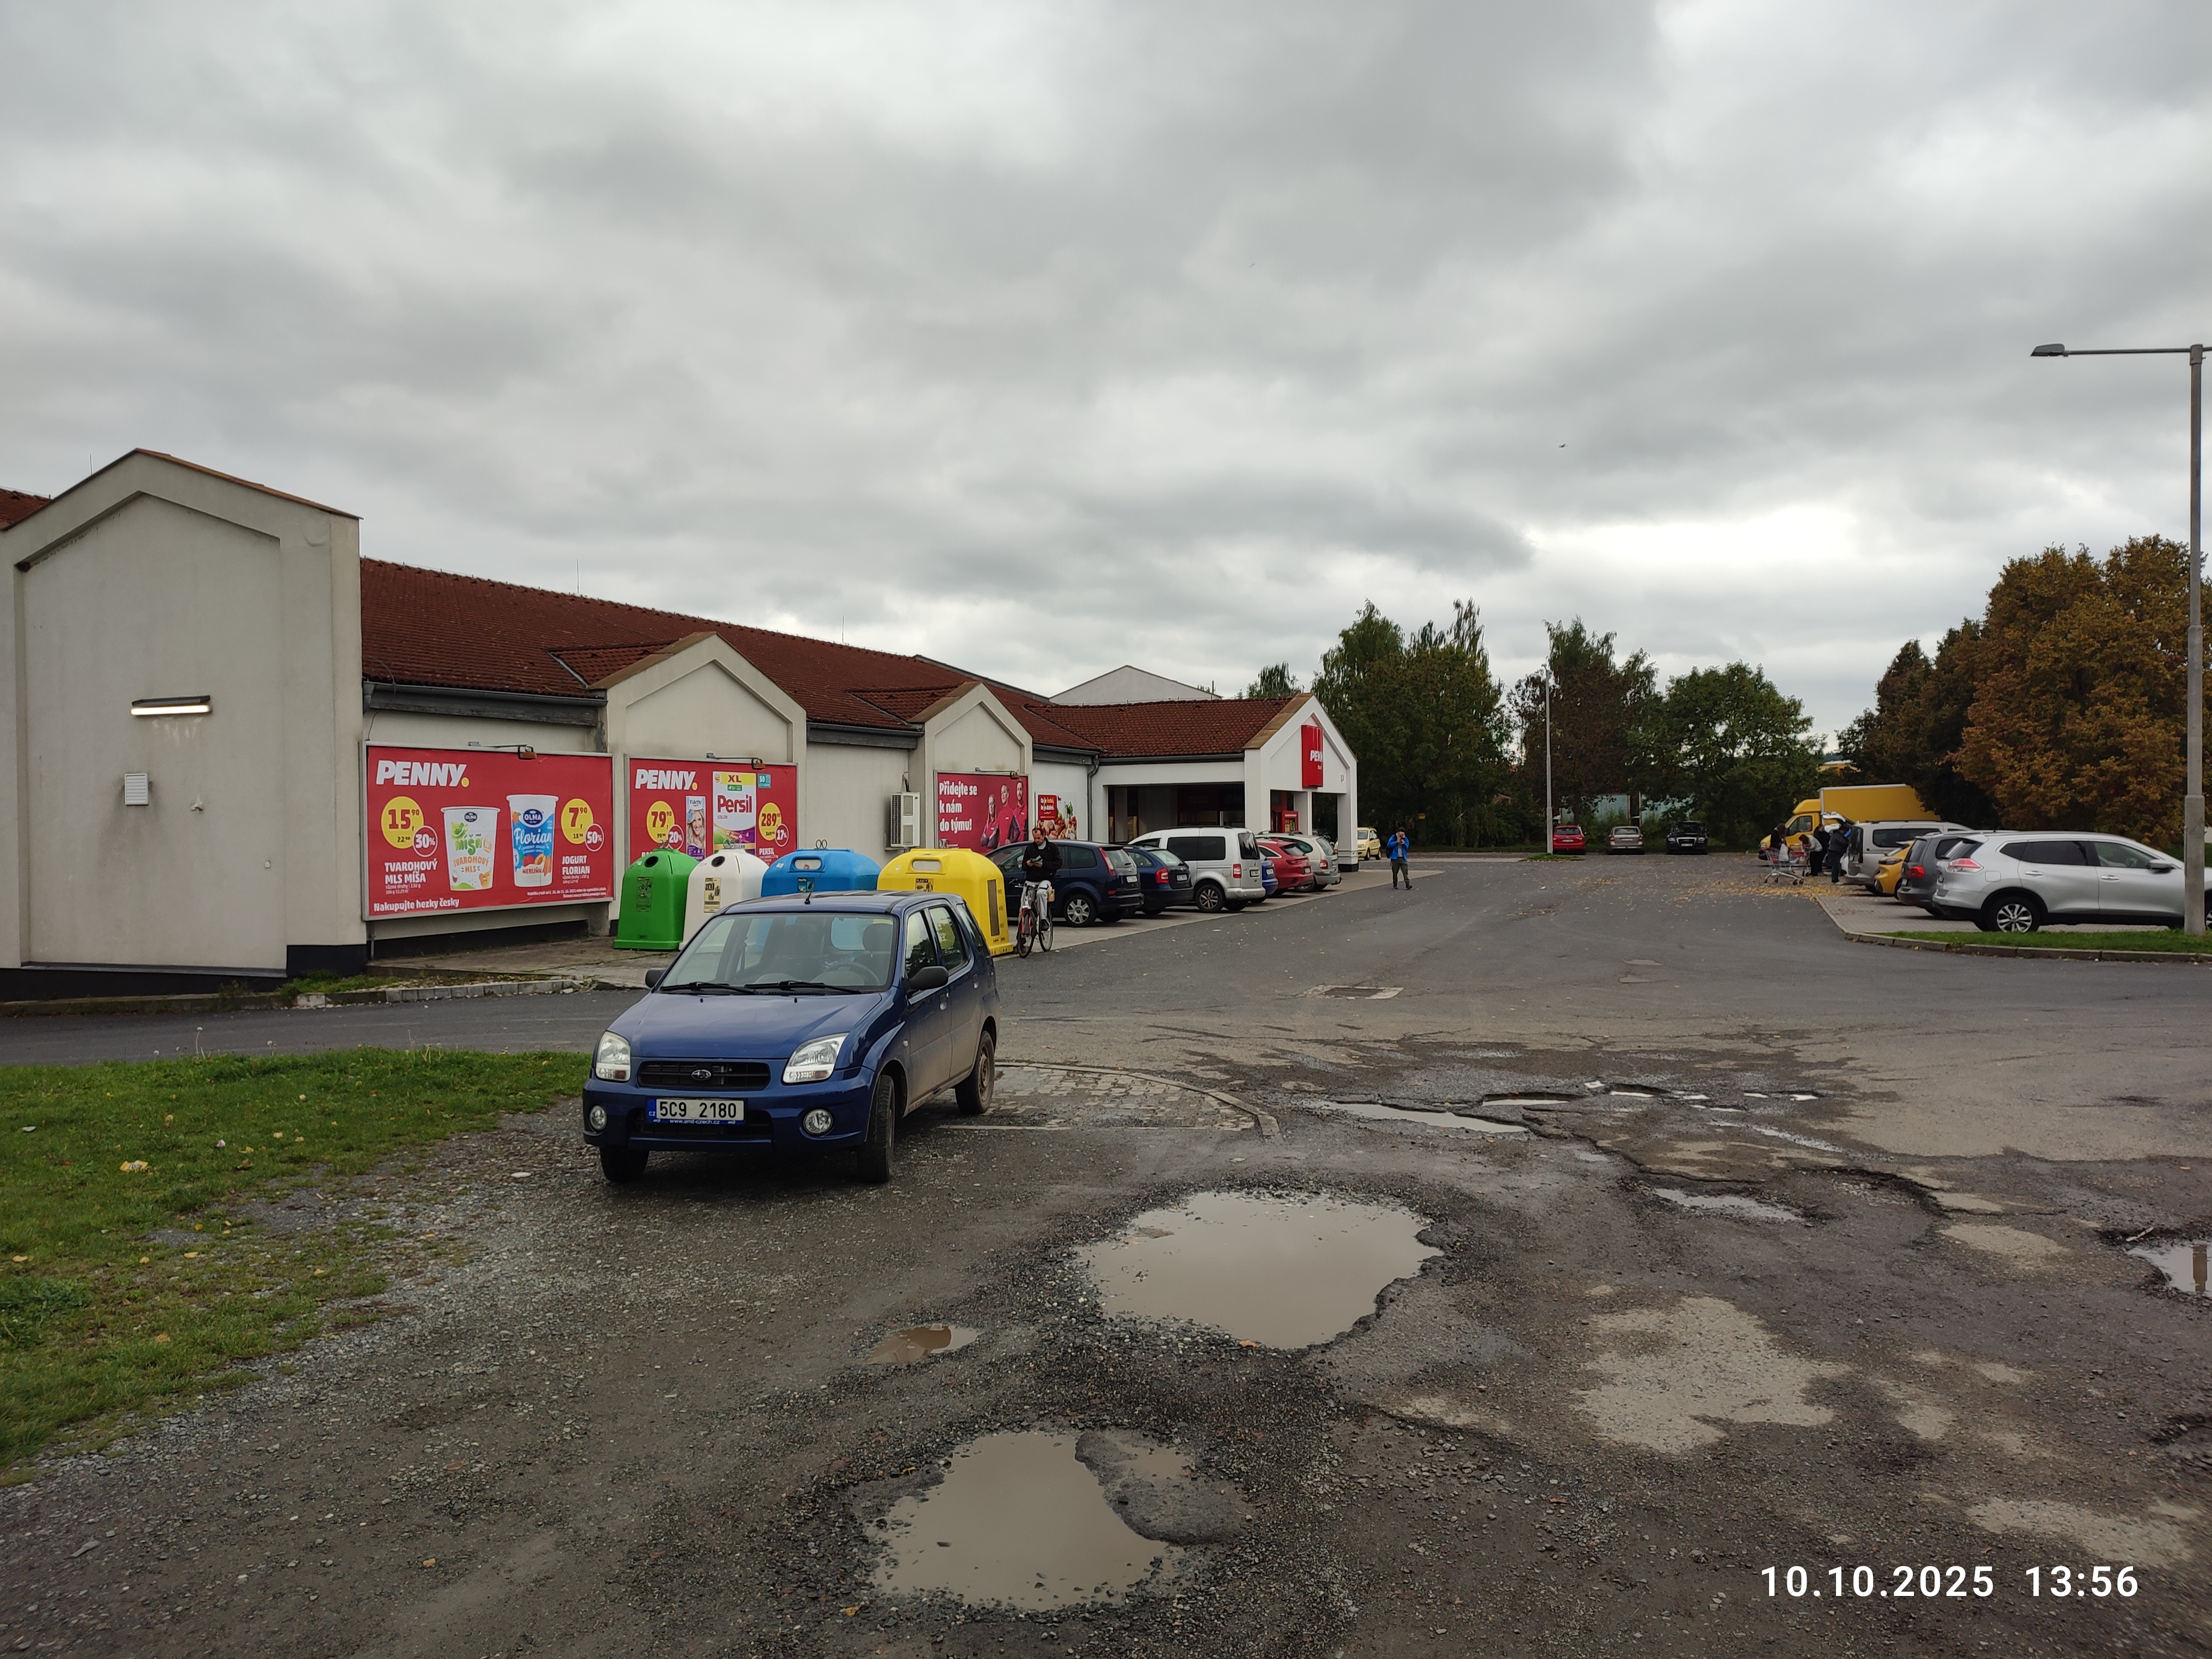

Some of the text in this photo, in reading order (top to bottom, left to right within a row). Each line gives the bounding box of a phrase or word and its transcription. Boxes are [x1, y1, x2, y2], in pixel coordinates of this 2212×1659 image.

[939, 780, 977, 798] Přidejte se
[717, 794, 752, 813] Persil
[939, 799, 962, 813] k nám
[940, 816, 972, 834] do týmu!
[415, 833, 436, 848] 30%
[514, 827, 552, 846] Florian
[587, 831, 602, 844] 50%
[669, 831, 682, 843] 20%
[384, 858, 437, 872] TVAROHOVÝ
[562, 855, 587, 865] JOGURT
[562, 865, 590, 875] FLORIAN
[385, 870, 426, 885] MLS MÍŠA
[374, 898, 460, 912] Nakupujte hezky česky
[660, 1101, 737, 1118] 5C9 2180
